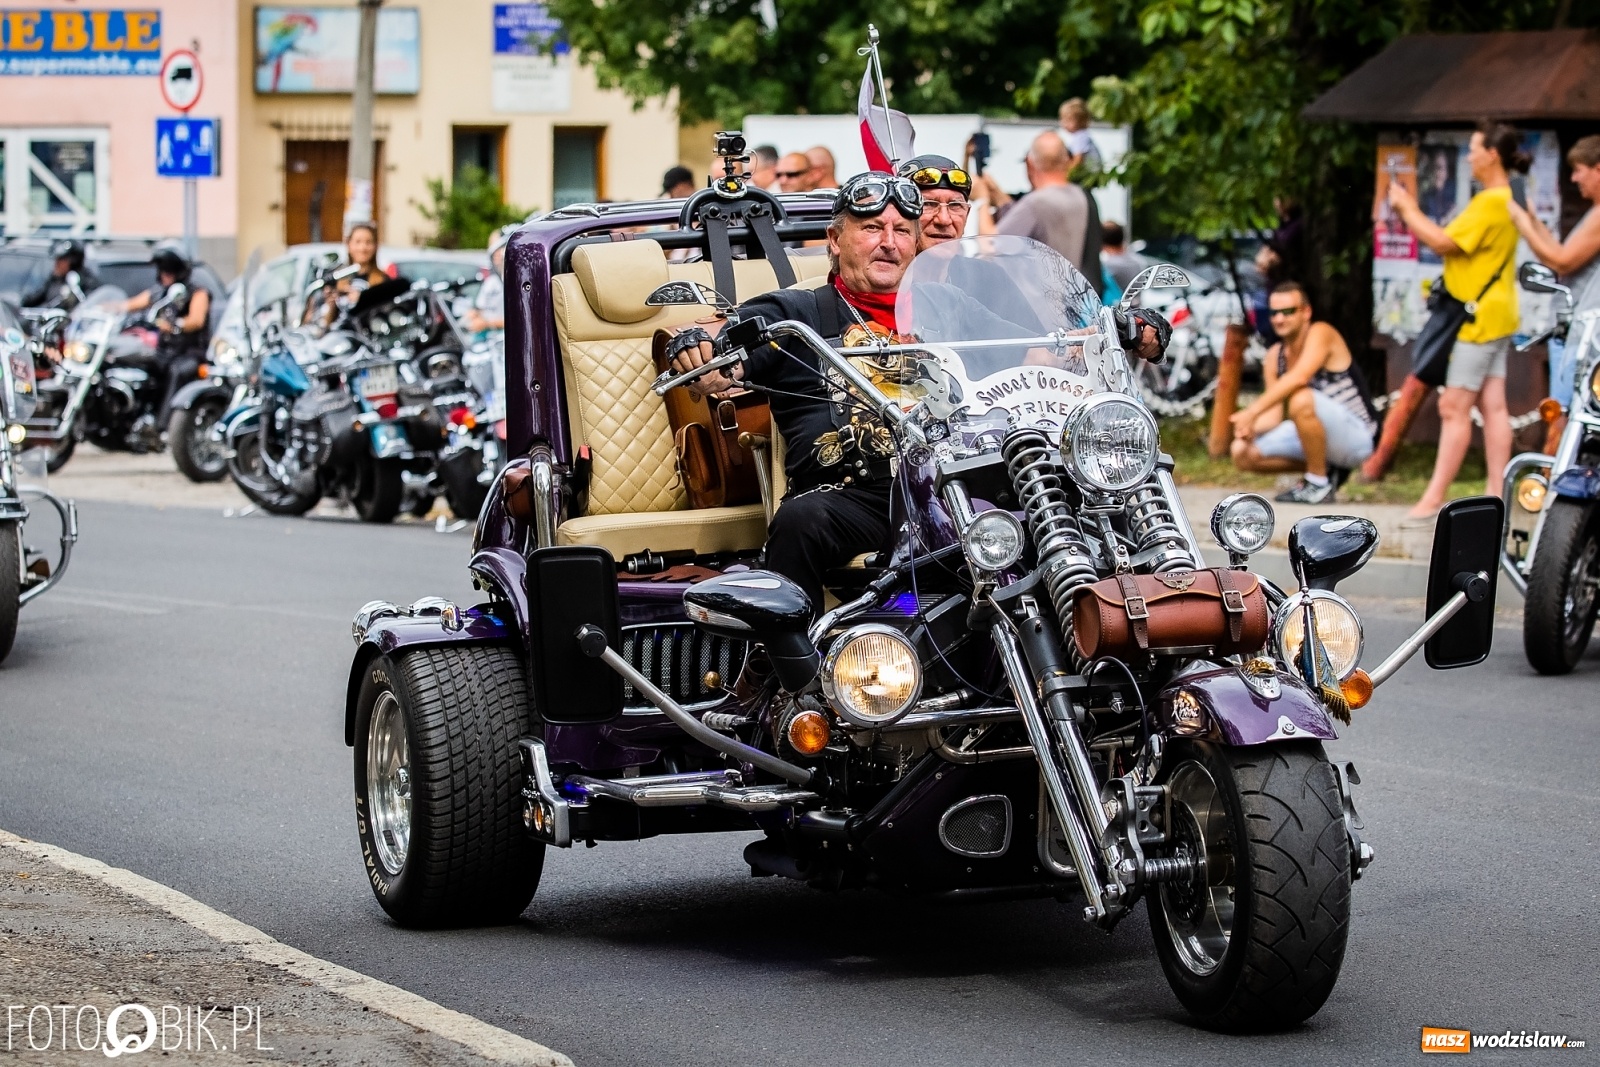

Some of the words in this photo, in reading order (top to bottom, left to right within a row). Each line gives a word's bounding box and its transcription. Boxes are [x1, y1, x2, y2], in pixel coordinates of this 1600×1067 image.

[0, 12, 160, 51] EBLE
[975, 372, 1031, 407] Sweet
[1010, 400, 1069, 417] TRIKE
[364, 841, 390, 896] RADIAL
